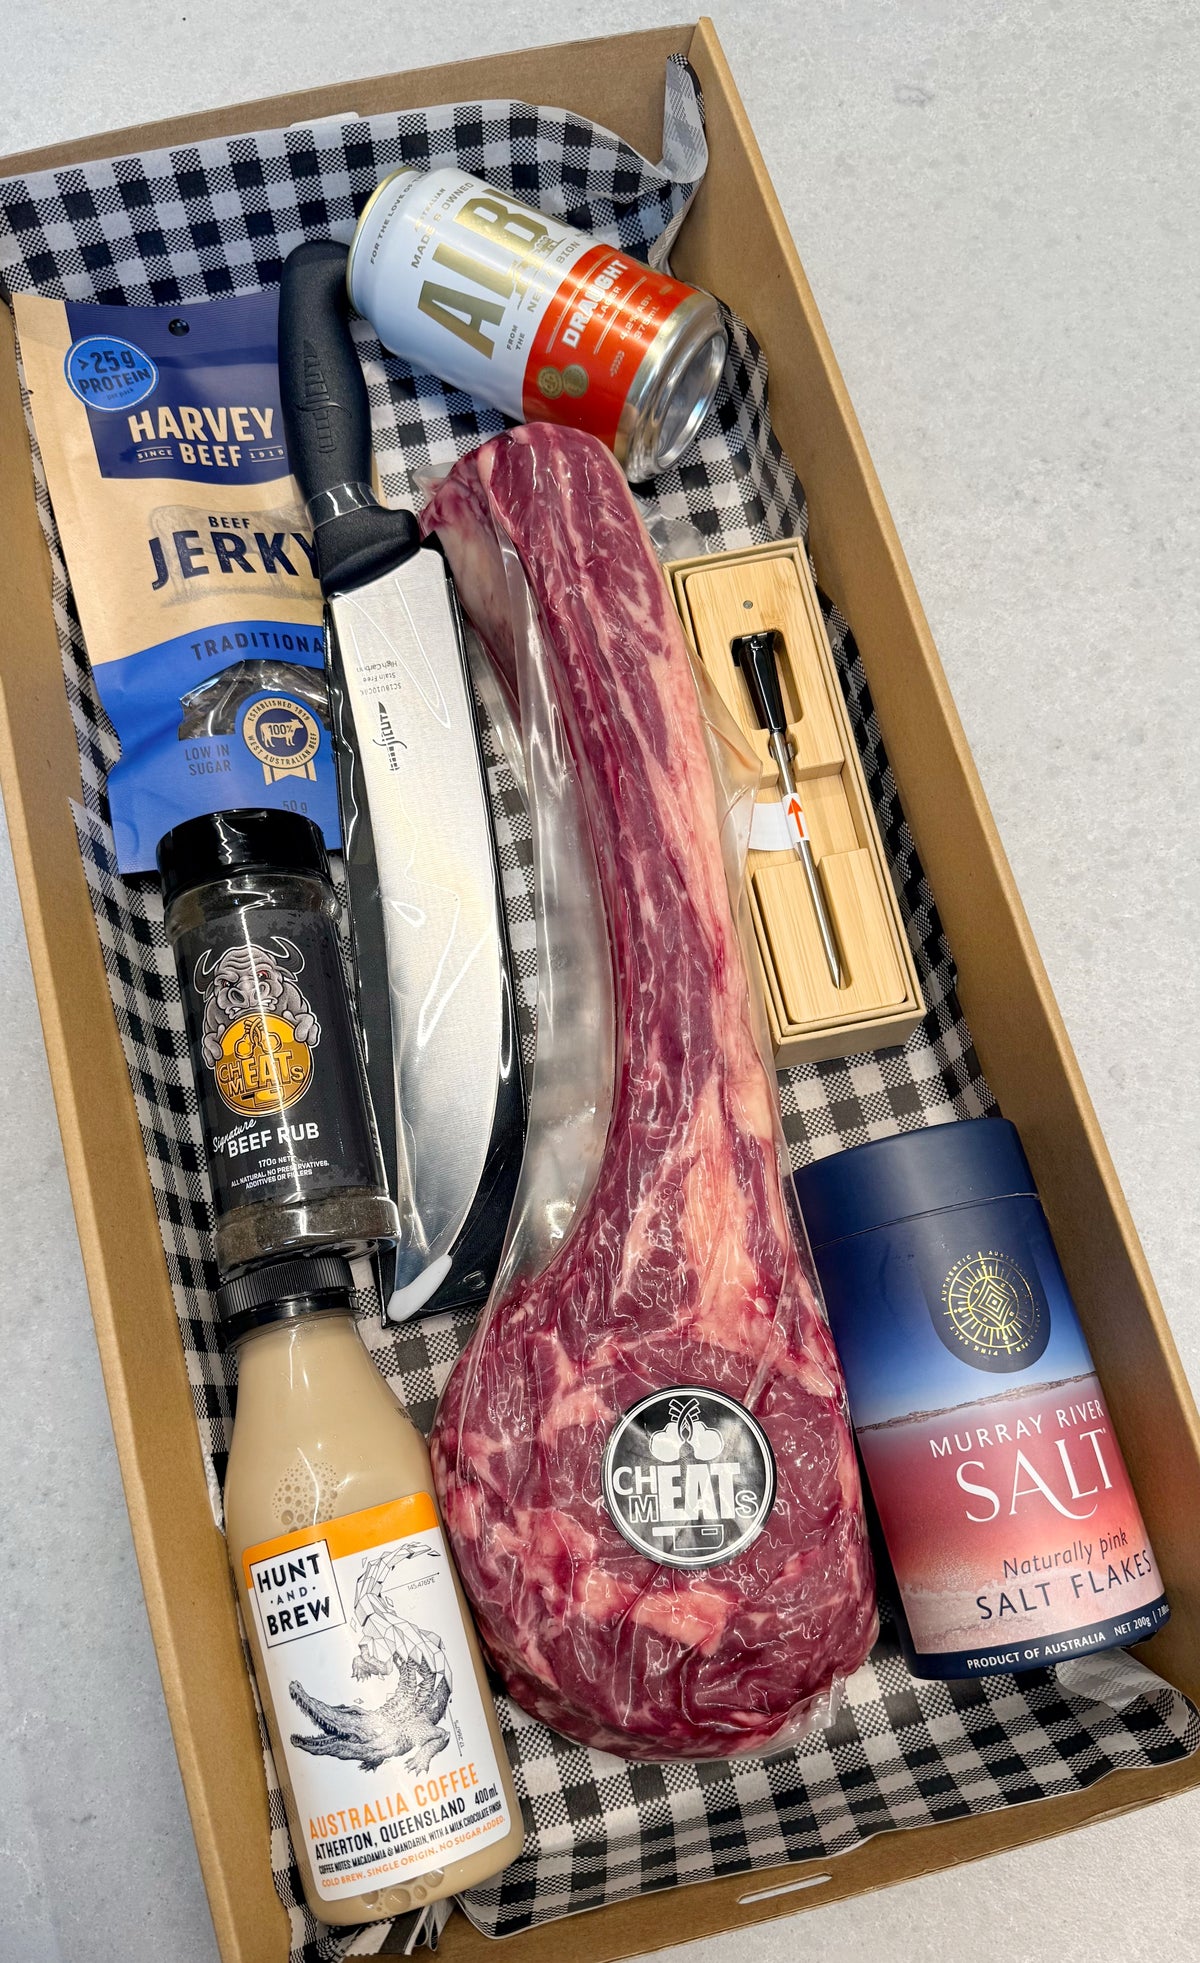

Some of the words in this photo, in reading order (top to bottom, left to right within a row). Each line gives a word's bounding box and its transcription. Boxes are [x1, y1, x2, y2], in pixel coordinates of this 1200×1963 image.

[370, 243, 380, 264] FOR
[377, 219, 390, 240] THE
[388, 194, 405, 217] LOVE
[411, 225, 436, 269] MADE
[441, 181, 474, 211] OWNED
[562, 259, 628, 349] DRAUGHT
[507, 324, 518, 351] FROM
[515, 332, 526, 351] THE
[78, 368, 152, 395] PROTEIN
[127, 406, 274, 443] HARVEY
[137, 449, 173, 460] SINCE
[179, 443, 242, 467] BEEF
[208, 516, 251, 529] BEEF
[148, 529, 320, 591] JERKY
[190, 632, 325, 661] TRADITIONA
[247, 700, 292, 722] ESTABLISHED
[268, 724, 294, 736] 100%
[185, 747, 214, 761] LOW
[217, 744, 230, 757] IN
[248, 734, 264, 755] WEST
[263, 749, 311, 766] AUSTRALIAN
[308, 732, 317, 750] BEEF
[188, 760, 232, 776] SUGAR
[212, 1118, 257, 1154] Signature
[227, 1129, 273, 1158] BEEF
[276, 1122, 320, 1145] RUB
[245, 1175, 277, 1190] ADDITIVES
[277, 1173, 286, 1182] OR
[267, 1169, 276, 1178] NO
[949, 1325, 969, 1346] SALT
[929, 1414, 1042, 1459] MURRAY
[1055, 1399, 1105, 1429] RIVER
[956, 1428, 1113, 1523] SALT
[1003, 1540, 1093, 1579] Naturally
[1099, 1527, 1129, 1560] pink
[257, 1553, 320, 1593] HUNT
[976, 1582, 1051, 1620] SALT
[1070, 1549, 1152, 1599] FLAKES
[266, 1595, 330, 1636] BREW
[967, 1652, 1020, 1670] PRODUCT
[1024, 1647, 1040, 1660] OF
[1044, 1631, 1106, 1656] AUSTRALIA
[1114, 1623, 1132, 1637] NET
[1132, 1616, 1152, 1631] 200g
[309, 1792, 410, 1840] AUSTRALIA
[414, 1762, 479, 1808] COFFEE
[315, 1831, 378, 1861] ATHERTON,
[379, 1797, 466, 1843] QUEENSLAND
[319, 1864, 335, 1876] COFFEE
[351, 1849, 387, 1868] MACADAMIA
[428, 1826, 444, 1842] WITH
[444, 1826, 450, 1835] A
[449, 1817, 464, 1834] MILK
[462, 1807, 490, 1828] CHOCOLATE
[321, 1876, 339, 1888] COLD
[341, 1872, 367, 1884] BREW.
[366, 1859, 400, 1878] SINGLE
[400, 1846, 439, 1867] ORIGIN.
[439, 1840, 454, 1852] NO
[454, 1826, 482, 1846] SUGAR
